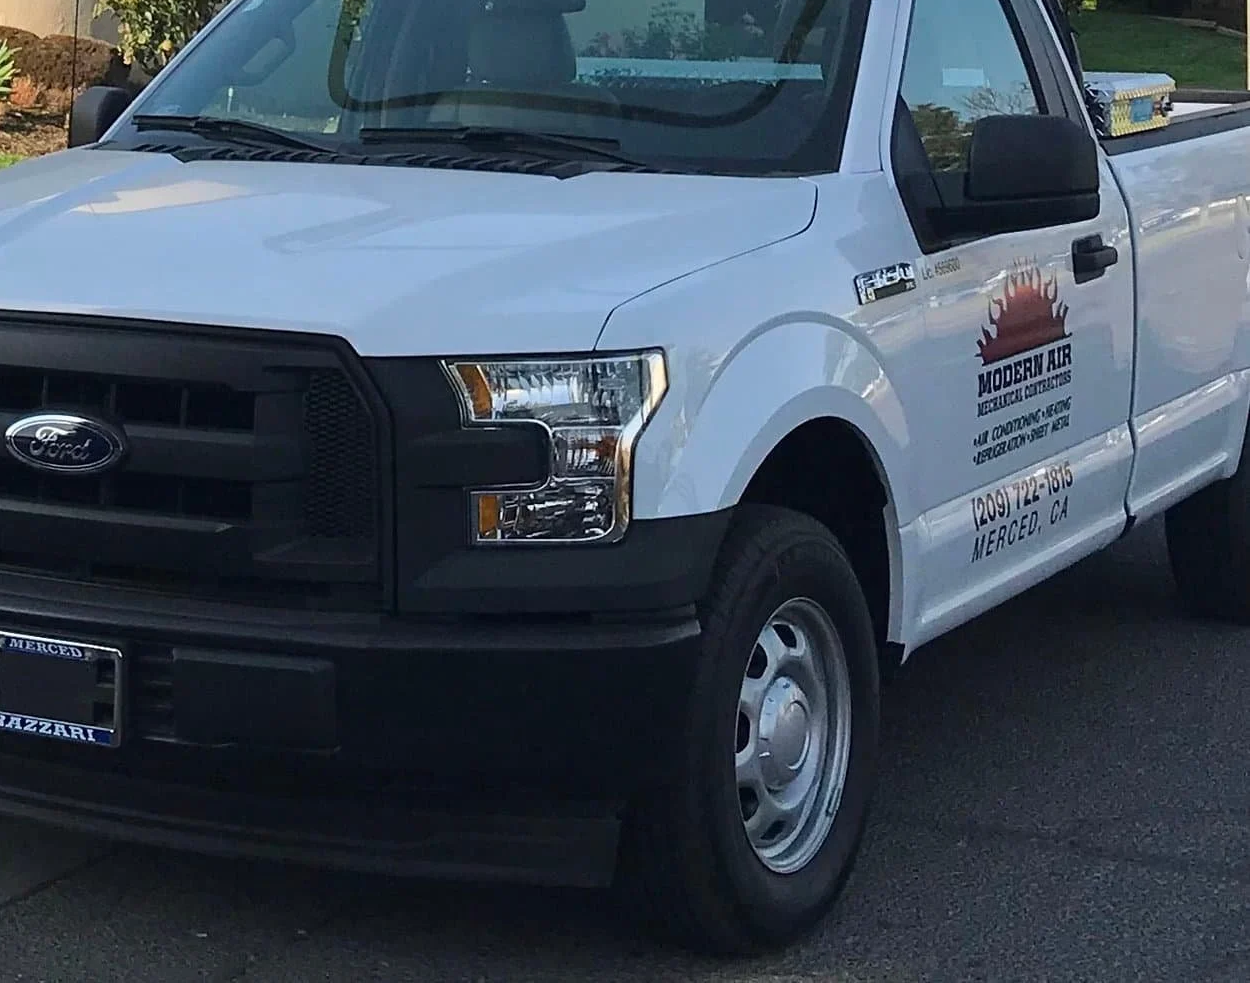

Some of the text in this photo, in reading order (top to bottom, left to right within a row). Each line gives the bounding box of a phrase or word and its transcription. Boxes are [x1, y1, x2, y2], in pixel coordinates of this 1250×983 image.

[976, 369, 1072, 417] MECHANICAL CONTRACTORS
[977, 343, 1072, 398] MODERN AIR
[30, 426, 92, 460] Ford
[991, 408, 1041, 442] CONDITIONING
[1044, 396, 1072, 419] HEATING
[972, 460, 1073, 532] (209) 722-1815
[971, 495, 1068, 564] MERCED, CA
[8, 637, 83, 658] MERCED
